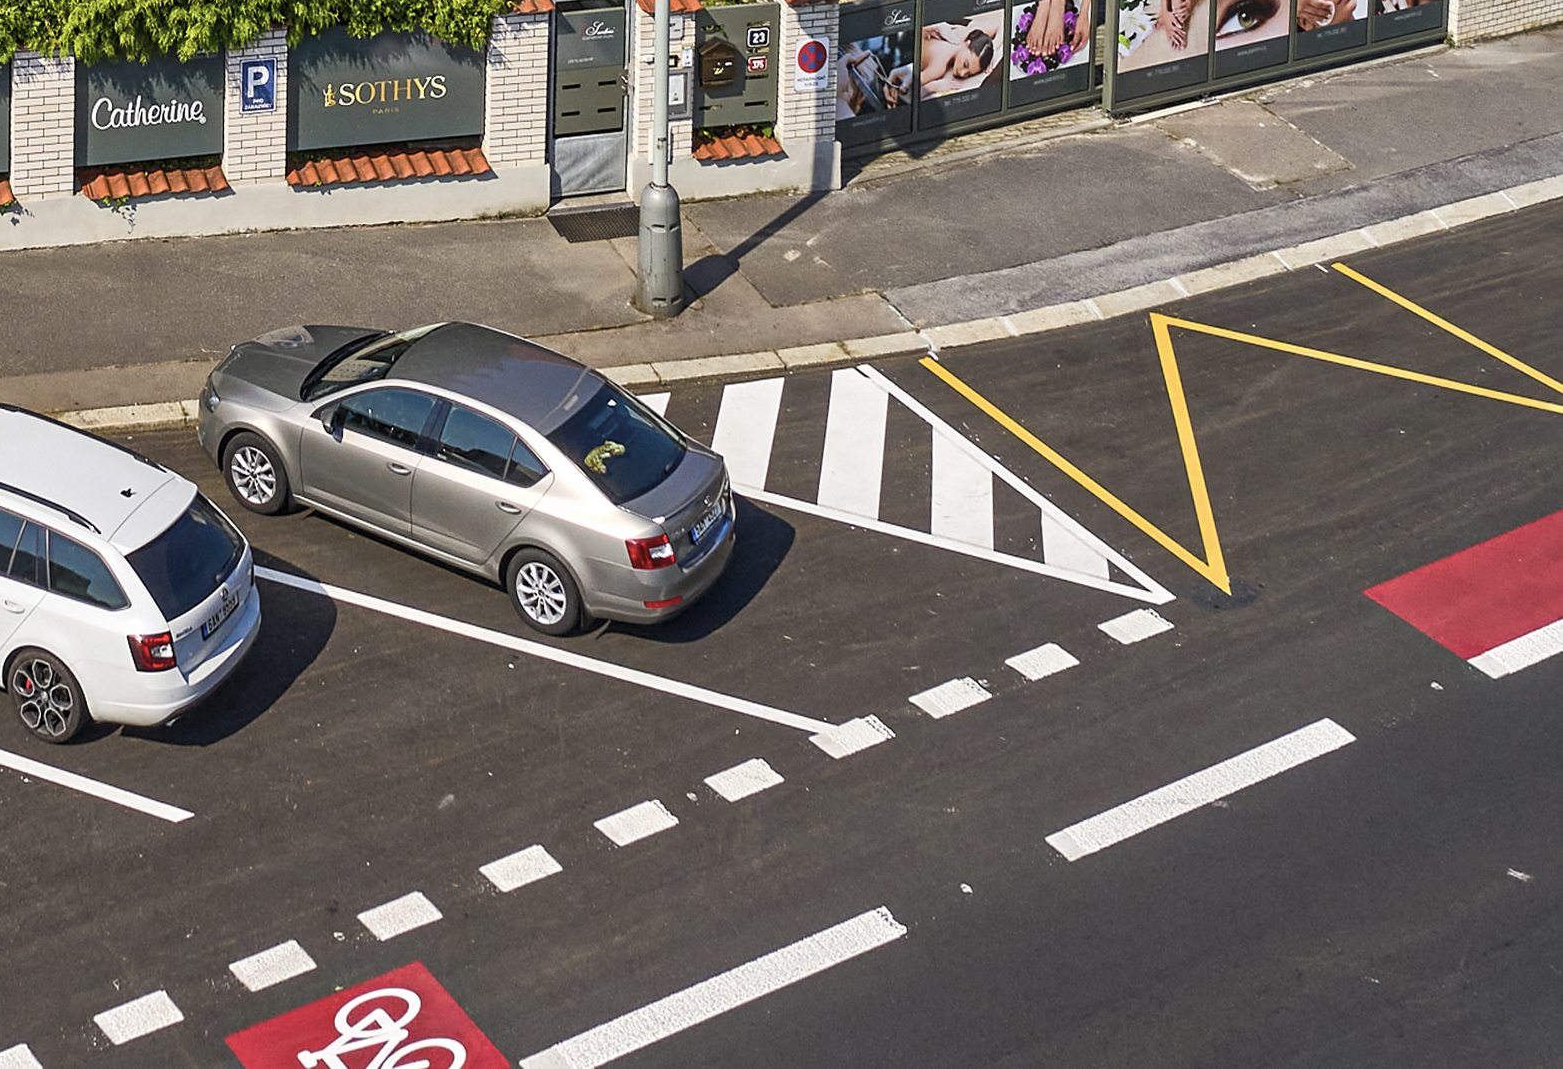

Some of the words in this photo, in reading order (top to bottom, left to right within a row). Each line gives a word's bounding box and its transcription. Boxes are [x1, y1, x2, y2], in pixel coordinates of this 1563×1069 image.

[752, 31, 766, 44] 23
[247, 65, 269, 98] P
[338, 75, 447, 106] SOTHYS
[92, 95, 204, 130] Catherine
